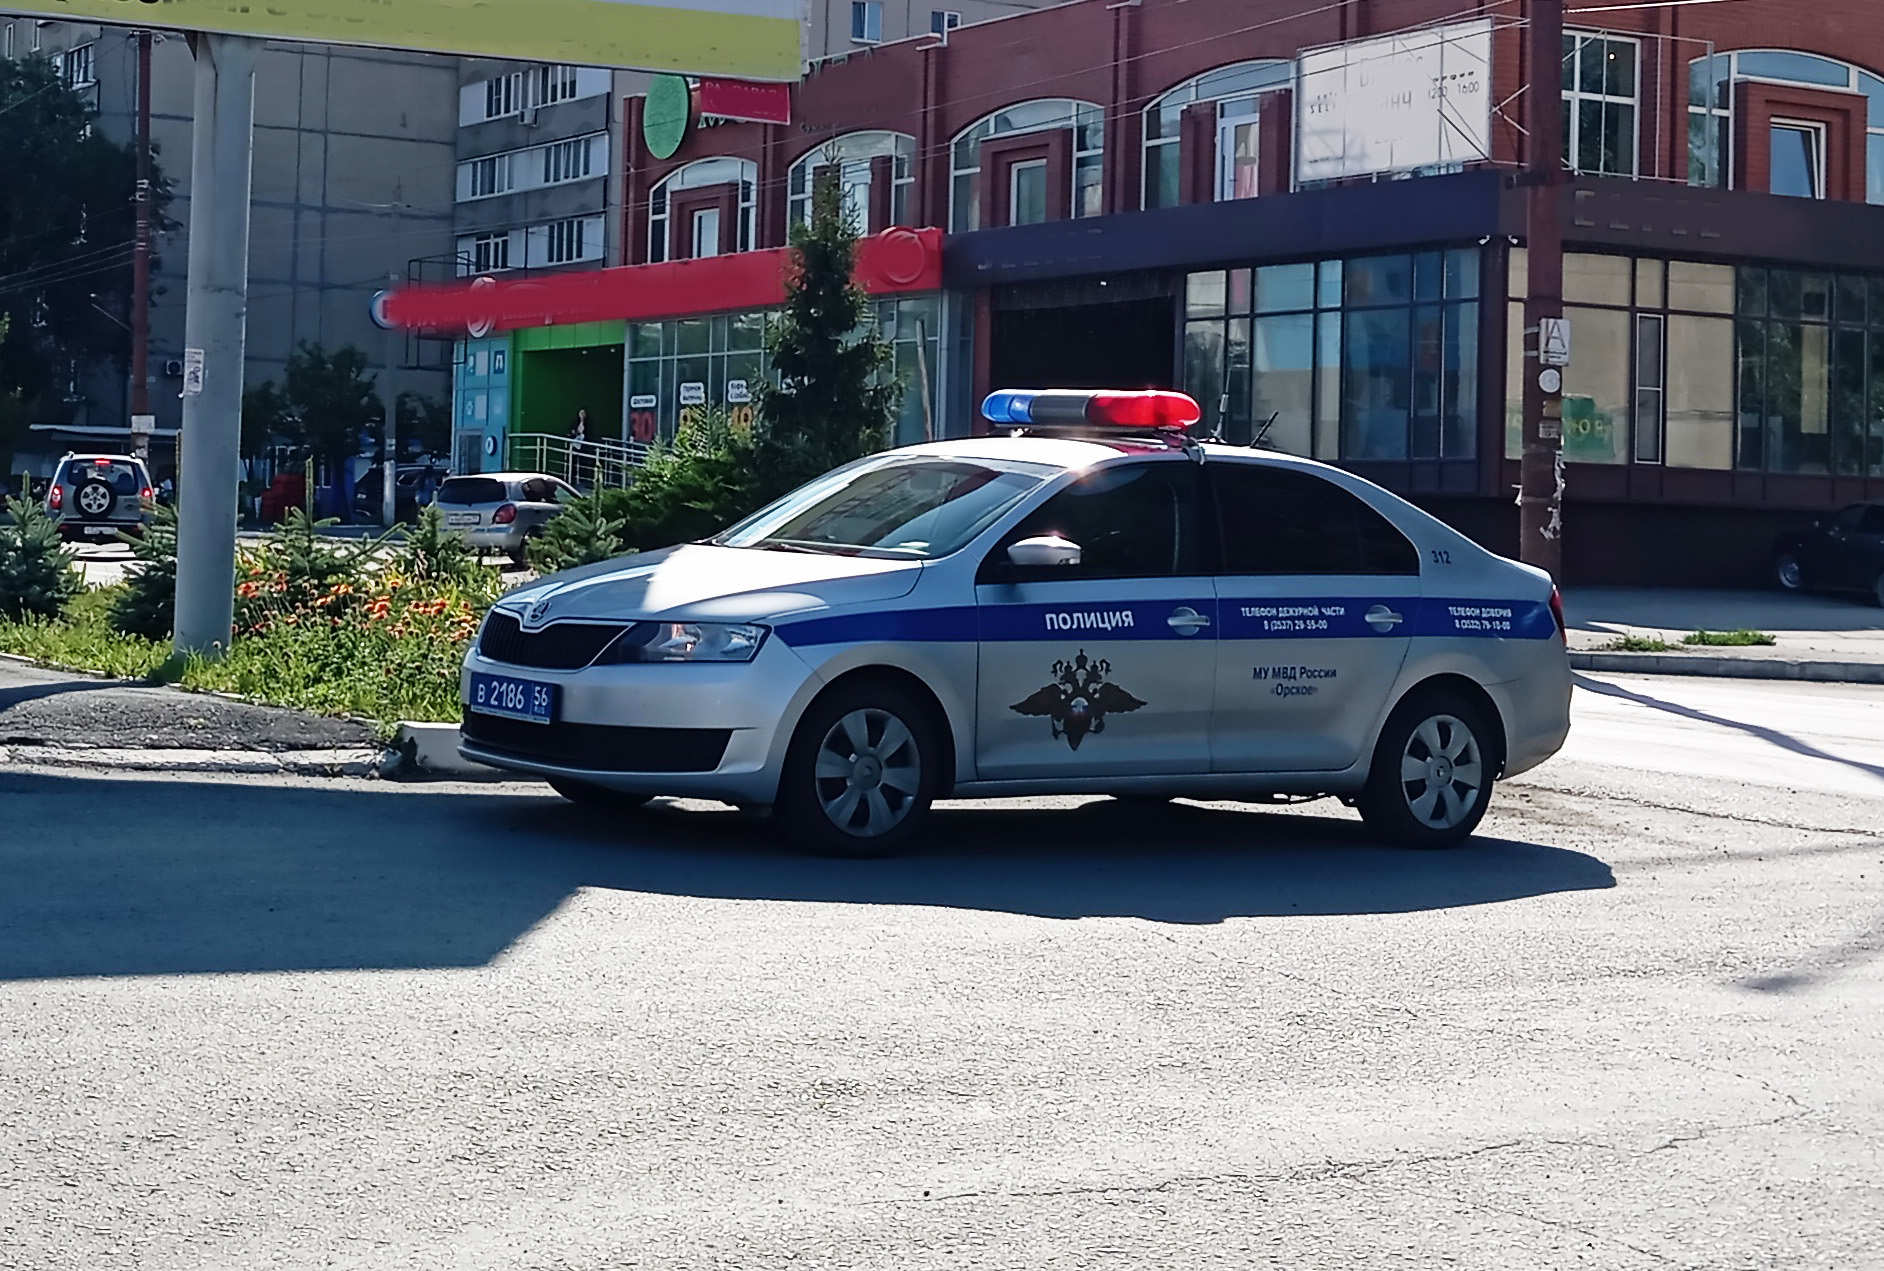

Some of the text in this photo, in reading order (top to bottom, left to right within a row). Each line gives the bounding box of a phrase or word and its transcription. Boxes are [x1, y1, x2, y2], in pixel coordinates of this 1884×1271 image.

[1431, 550, 1452, 565] 312
[1240, 605, 1345, 618] ТЕЛЕФОН ДЕЖУРНОЙ ЧАСТИ
[1448, 606, 1480, 617] ТЕЛЕФОН
[1045, 610, 1134, 631] ПОЛИЦИЯ
[1252, 666, 1336, 681] МУ МВД России
[490, 680, 525, 709] 2186
[533, 686, 548, 706] 56
